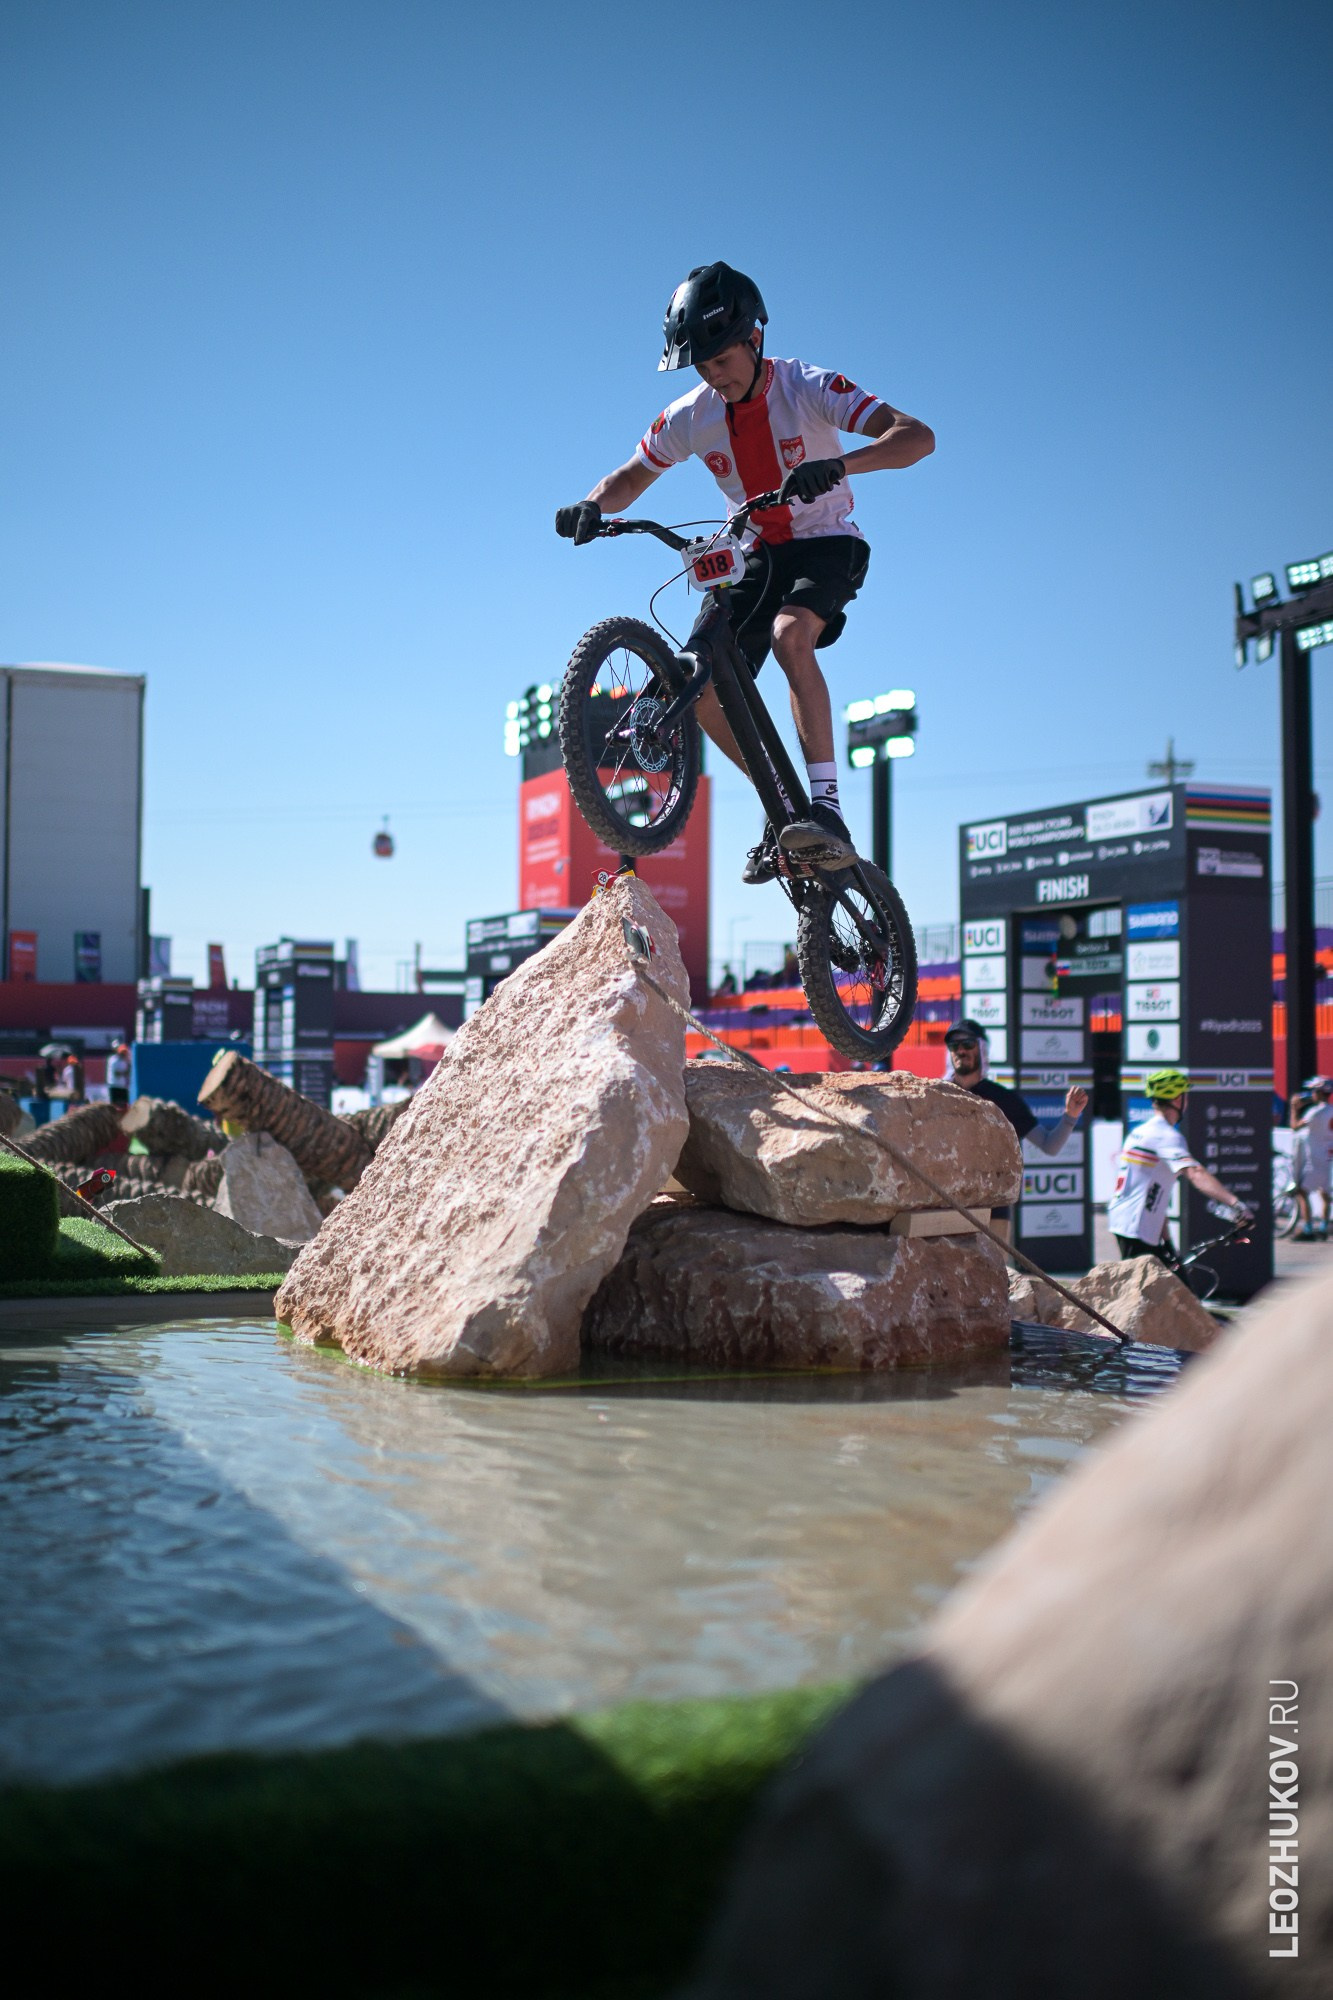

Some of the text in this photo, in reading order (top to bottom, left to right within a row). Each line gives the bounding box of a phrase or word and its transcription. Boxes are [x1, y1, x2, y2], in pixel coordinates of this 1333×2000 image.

[781, 438, 800, 446] POLAND
[698, 554, 728, 578] 318
[1044, 815, 1073, 830] CYCLING
[975, 831, 1003, 852] UCI
[1008, 825, 1085, 849] WORLD CHAMPIONSHIPS
[1038, 874, 1089, 902] FINISH
[1128, 911, 1179, 929] SHIMANO
[973, 927, 1000, 946] UCI
[971, 1008, 1000, 1018] TISSOT
[1136, 1000, 1172, 1012] TISSOT
[1031, 1009, 1075, 1020] TISSOT
[1040, 1073, 1066, 1086] UCI
[1218, 1073, 1245, 1087] UCI
[1035, 1174, 1076, 1194] UCI
